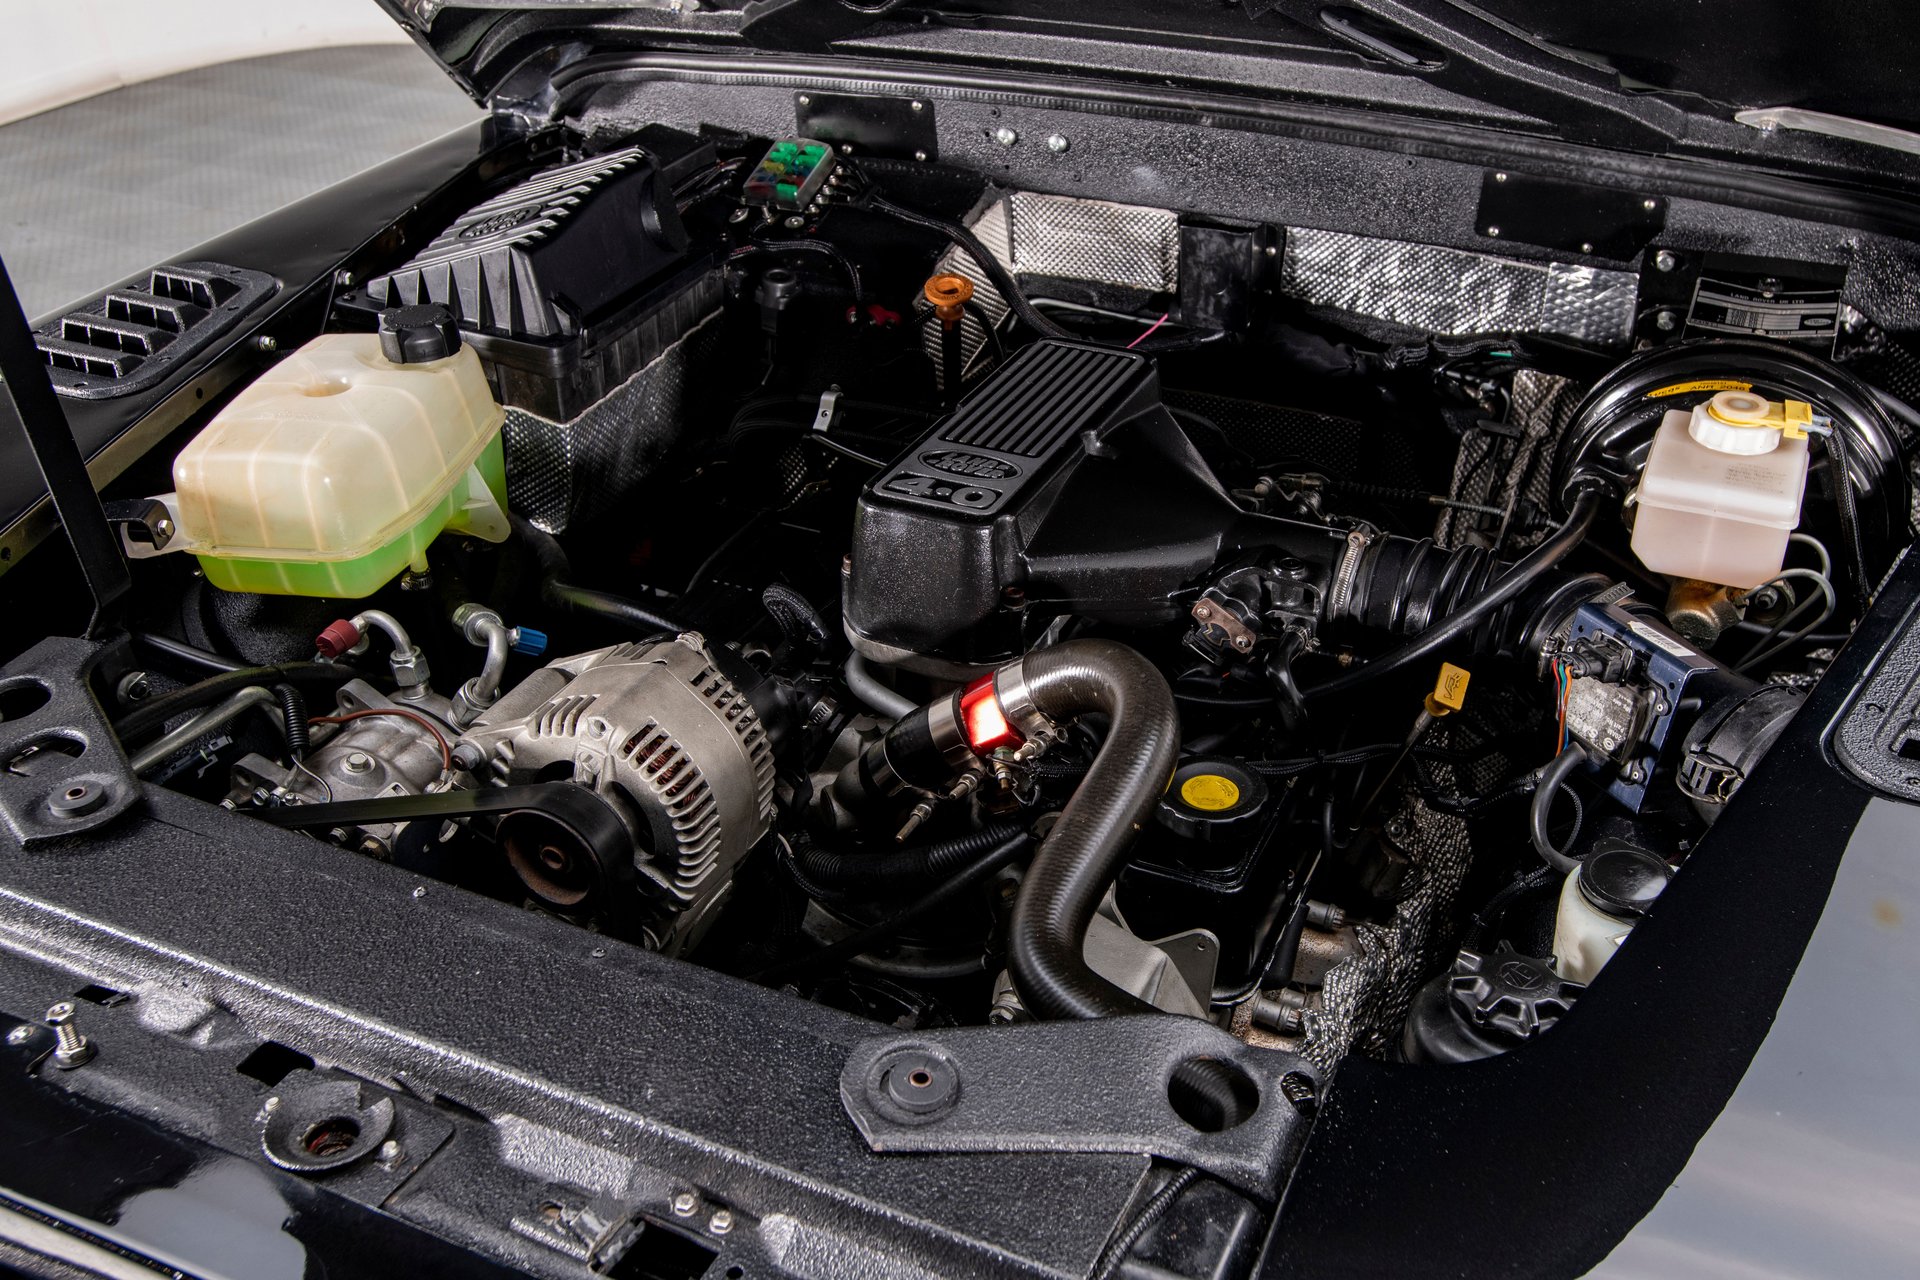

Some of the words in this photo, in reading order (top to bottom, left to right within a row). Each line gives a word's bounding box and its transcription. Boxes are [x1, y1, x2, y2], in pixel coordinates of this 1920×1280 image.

[1730, 292, 1750, 301] LAND
[941, 451, 998, 468] LAND
[934, 459, 1004, 478] ROVER
